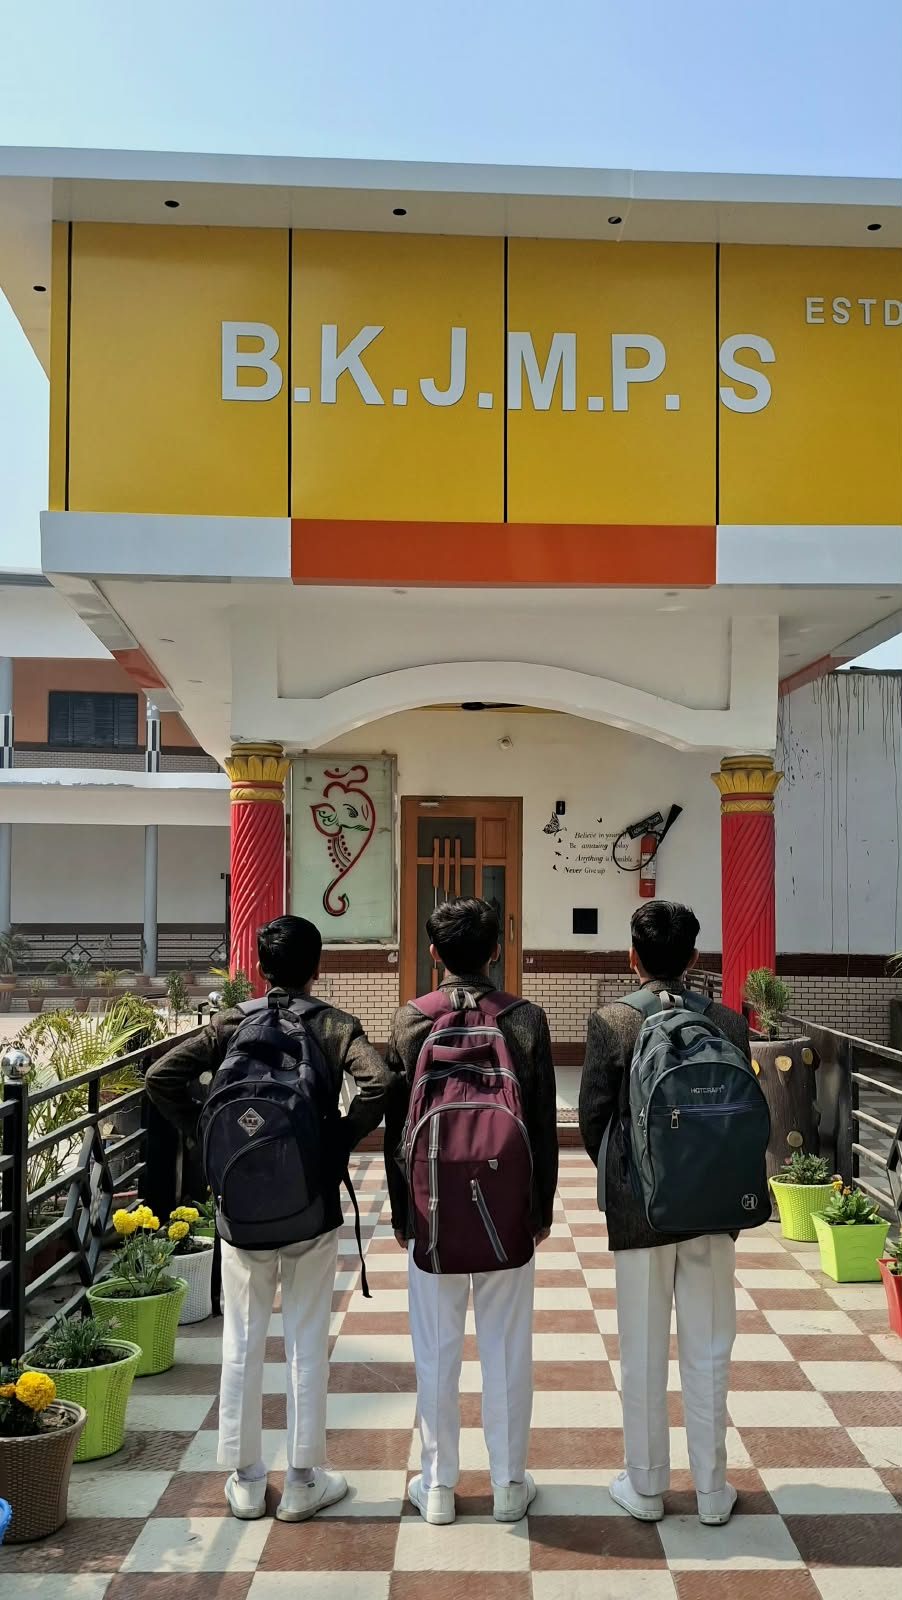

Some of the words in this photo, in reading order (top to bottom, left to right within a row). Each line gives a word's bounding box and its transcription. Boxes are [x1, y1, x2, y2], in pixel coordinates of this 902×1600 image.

[805, 296, 902, 326] ESTD
[581, 842, 609, 851] amazing
[575, 854, 604, 864] Anything
